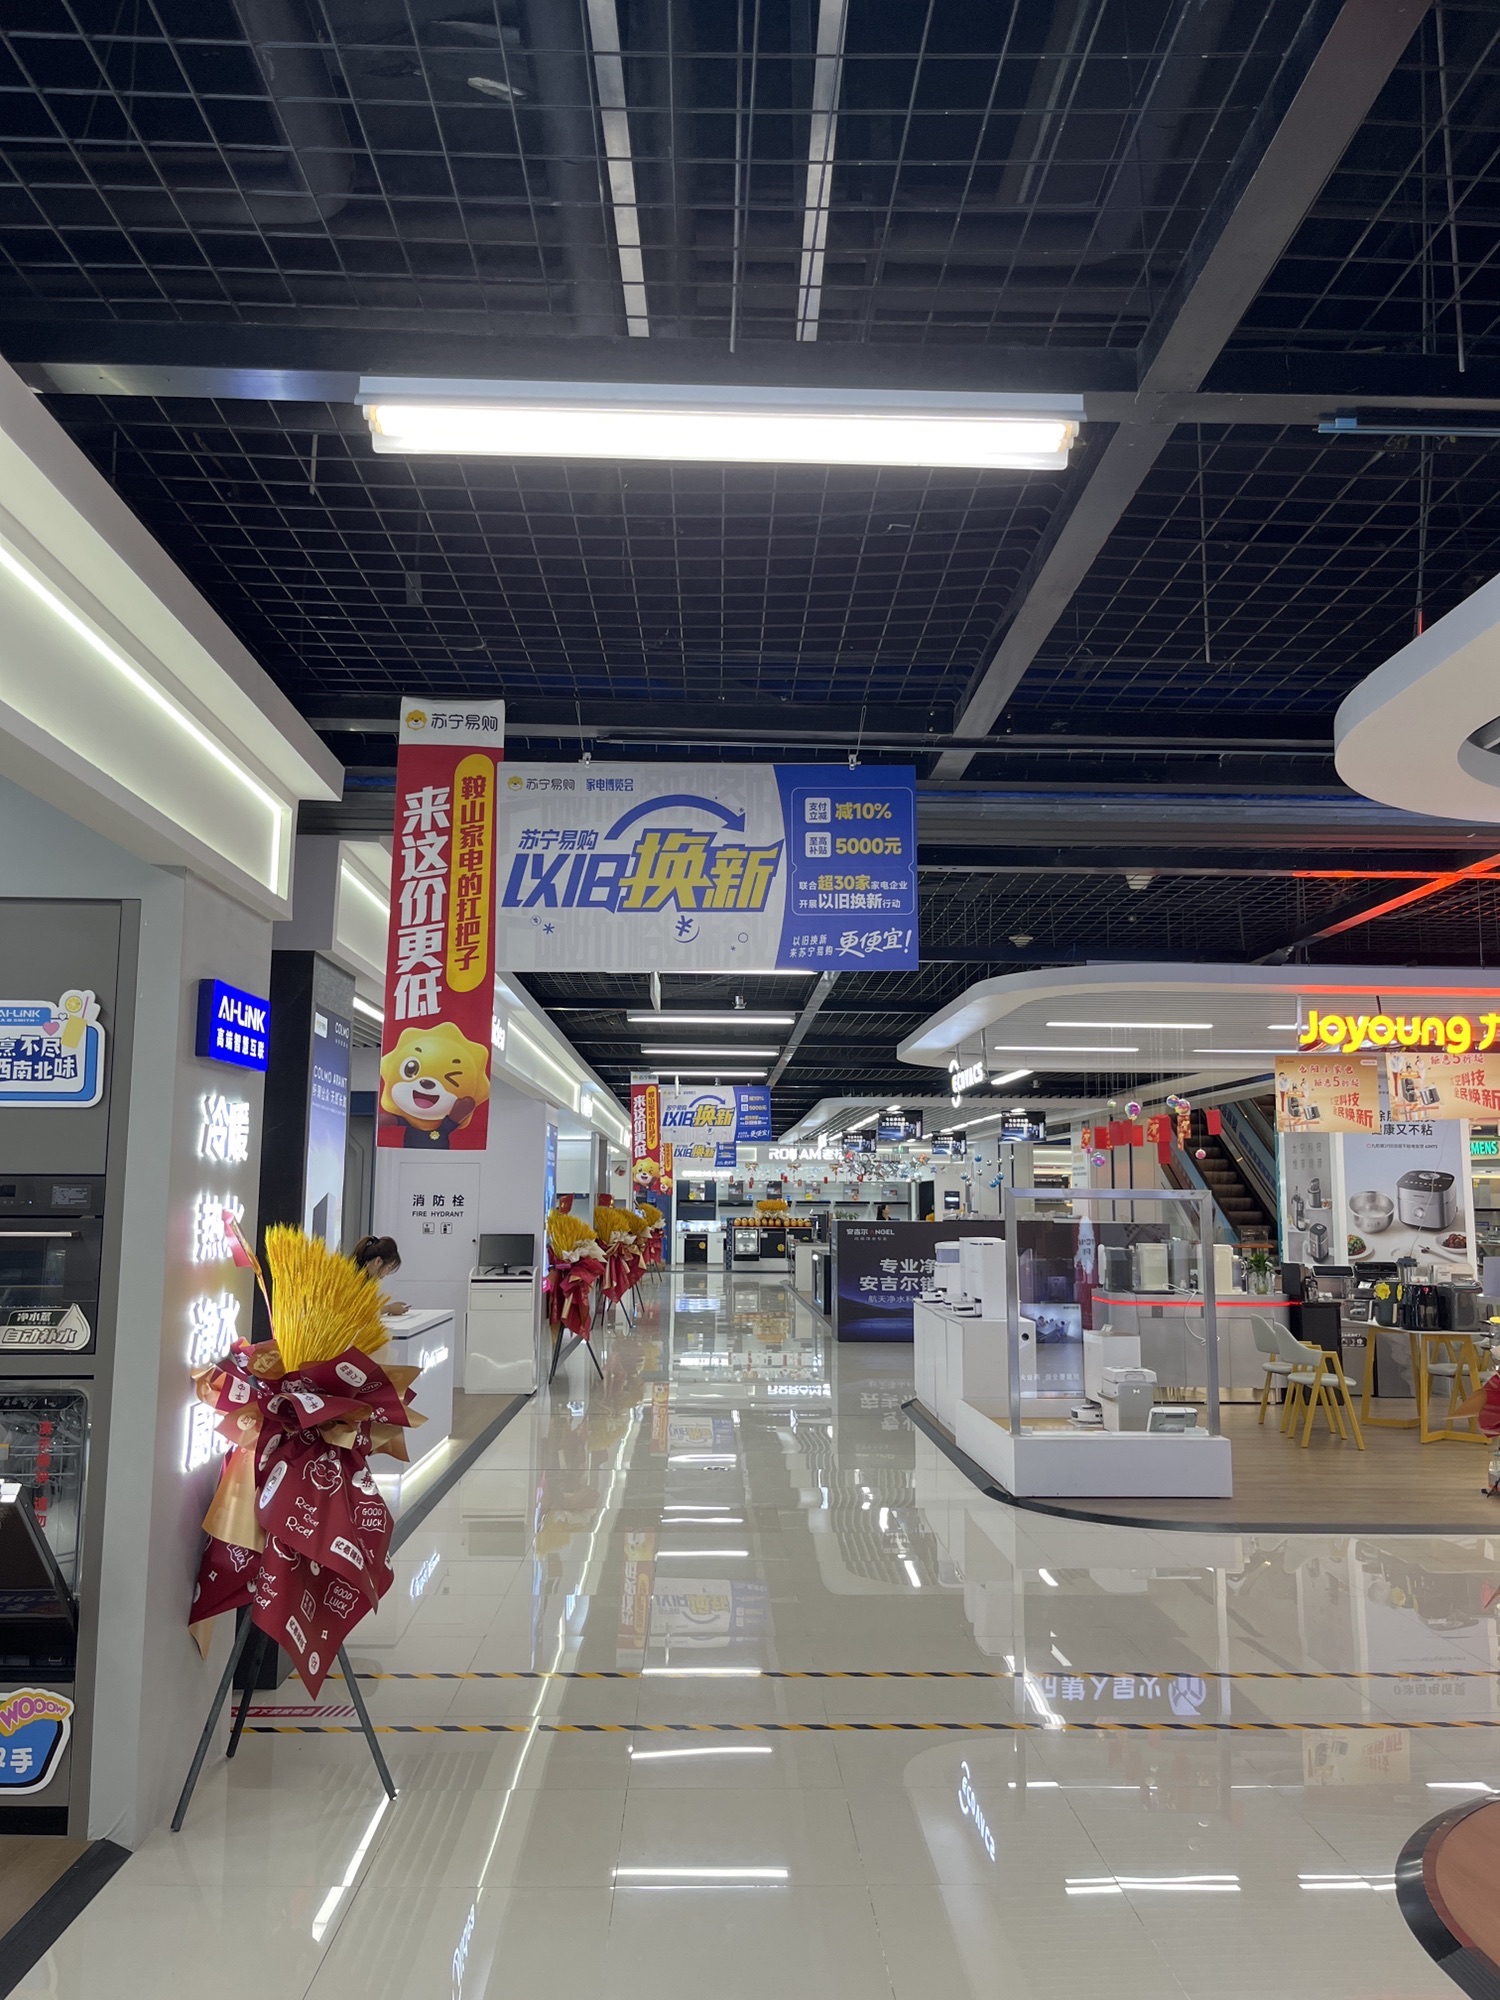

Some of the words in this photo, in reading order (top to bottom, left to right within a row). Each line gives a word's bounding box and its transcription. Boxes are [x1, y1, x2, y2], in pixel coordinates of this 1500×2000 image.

[431, 713, 498, 732] 苏宁易购
[526, 779, 575, 791] 苏宁易购
[586, 779, 635, 791] 家电博览会
[809, 803, 828, 811] 支付
[835, 803, 892, 820] 减10%
[809, 812, 828, 820] 立减
[518, 829, 599, 850] 苏宁易购
[809, 837, 828, 846] 至高
[835, 837, 902, 855] 5000元
[809, 846, 828, 855] 补贴
[454, 775, 487, 971] 鞍山家电的扛把子
[501, 828, 785, 914] 以旧换新
[798, 875, 908, 891] 联合超30家家电企业
[394, 786, 450, 1021] 来这价更低
[798, 893, 901, 909] 开展以旧换新行动
[793, 934, 828, 946] 以旧换新
[789, 945, 834, 958] 来苏宁易购
[1299, 1010, 1471, 1054] Joyoung
[216, 1027, 265, 1060] 高端智慧互联
[662, 1104, 735, 1128] 以旧换新
[197, 1095, 250, 1162] 冷暖
[412, 1194, 465, 1207] 消防栓
[879, 1258, 937, 1274] 专业净
[2, 1328, 77, 1344] 自动补水
[188, 1293, 240, 1365] 净水
[361, 1508, 383, 1516] GOOD
[361, 1518, 383, 1527] LUCK
[332, 1585, 353, 1601] GOOD
[329, 1596, 348, 1611] LUCK
